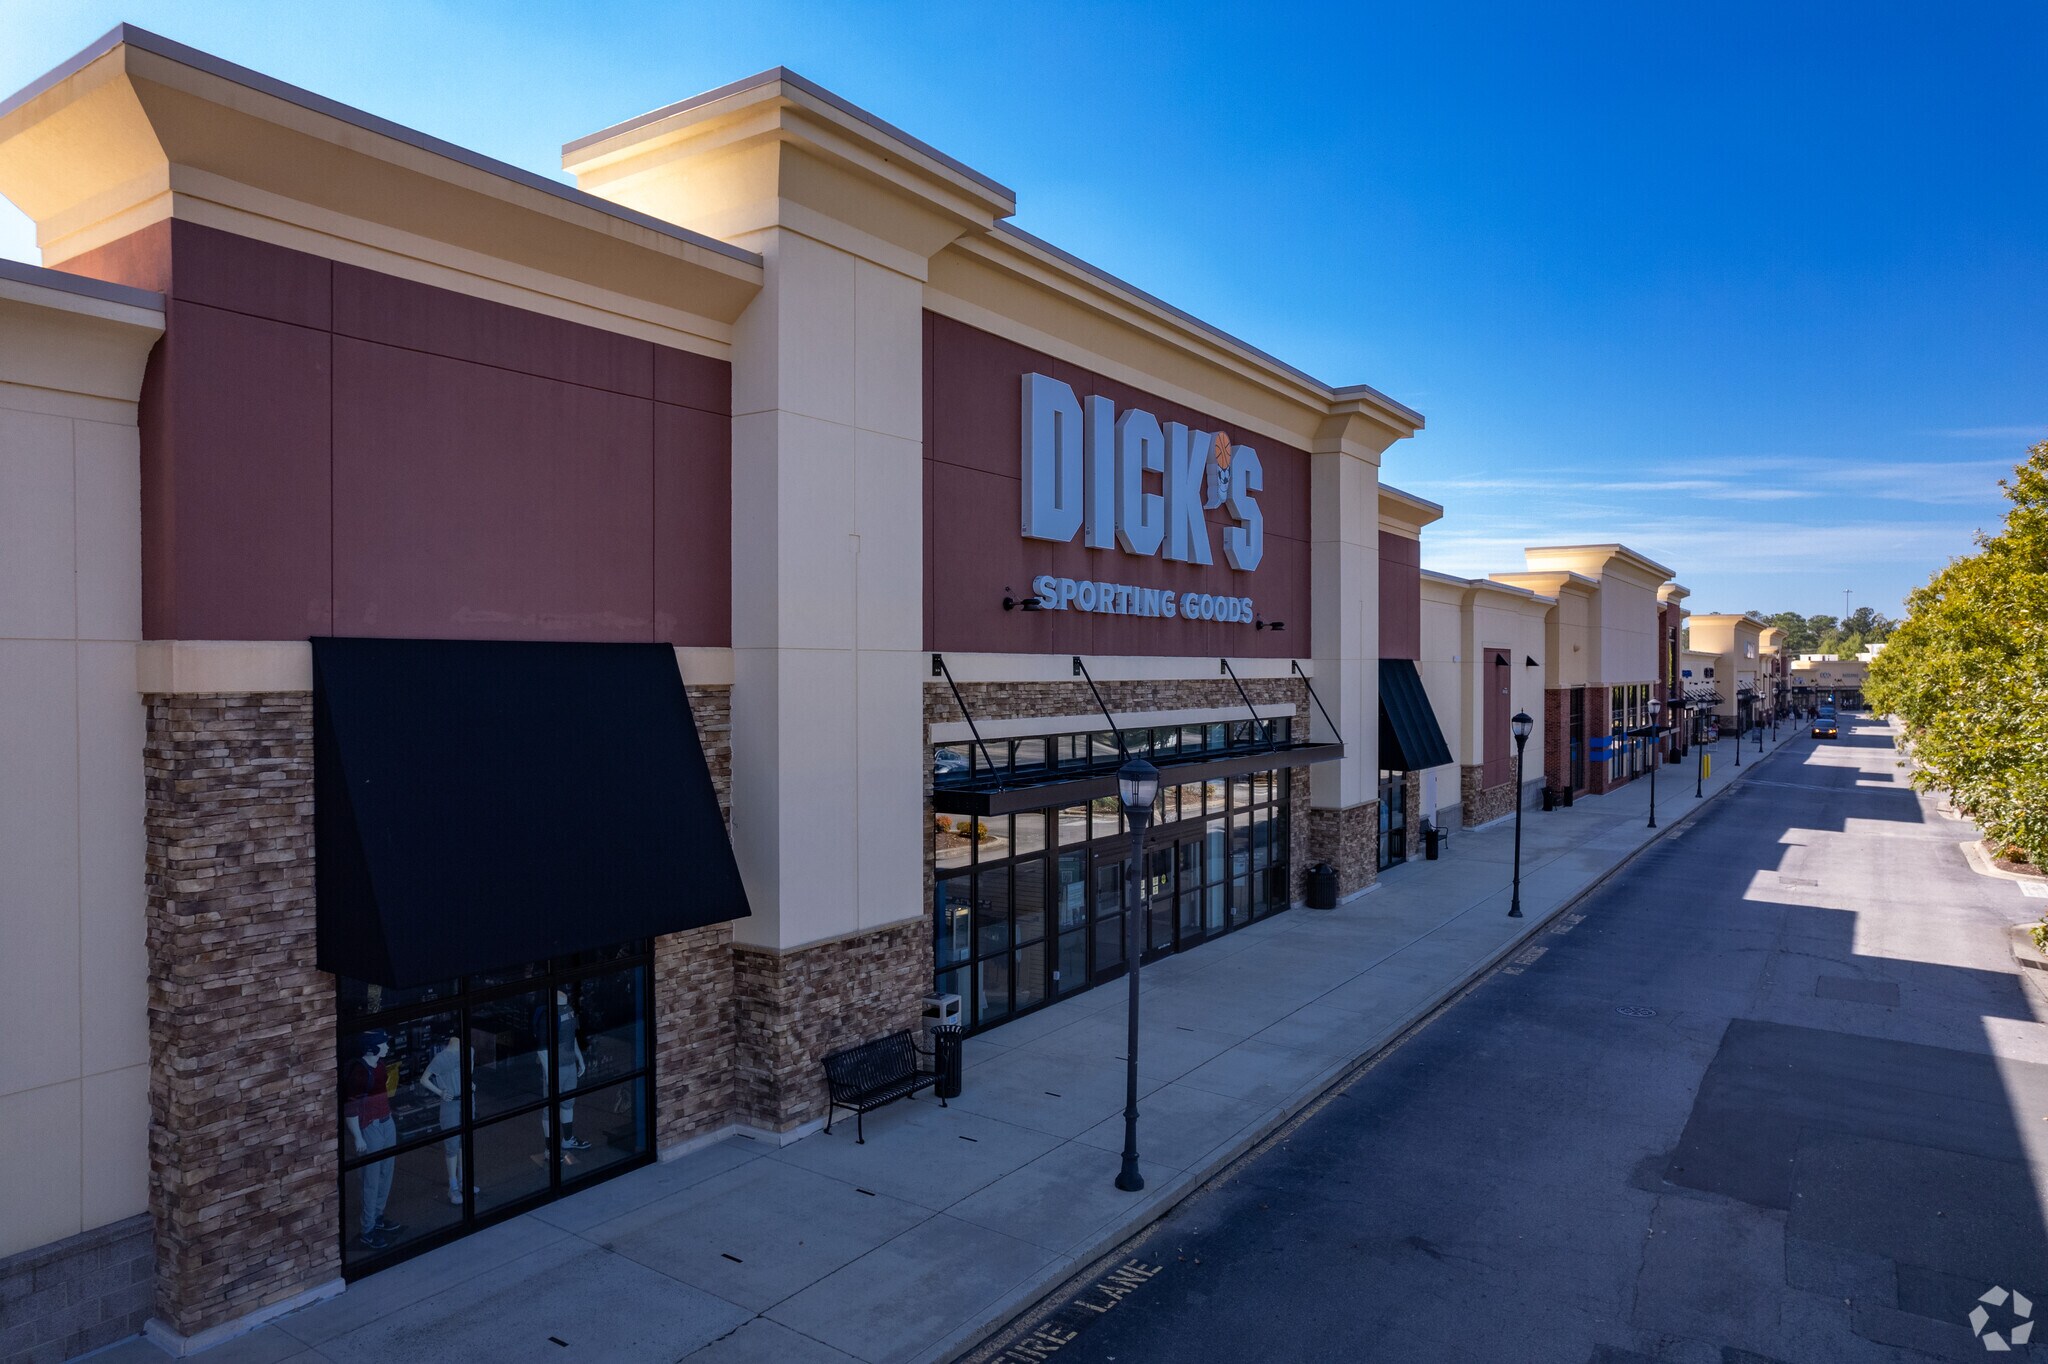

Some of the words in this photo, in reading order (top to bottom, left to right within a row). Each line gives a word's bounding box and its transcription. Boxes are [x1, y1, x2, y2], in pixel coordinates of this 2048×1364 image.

[1021, 372, 1263, 571] DICK'S
[1033, 575, 1176, 618] SPORTING
[1180, 592, 1253, 623] GOODS
[991, 1322, 1078, 1364] IRE
[1074, 1258, 1163, 1313] LANE
